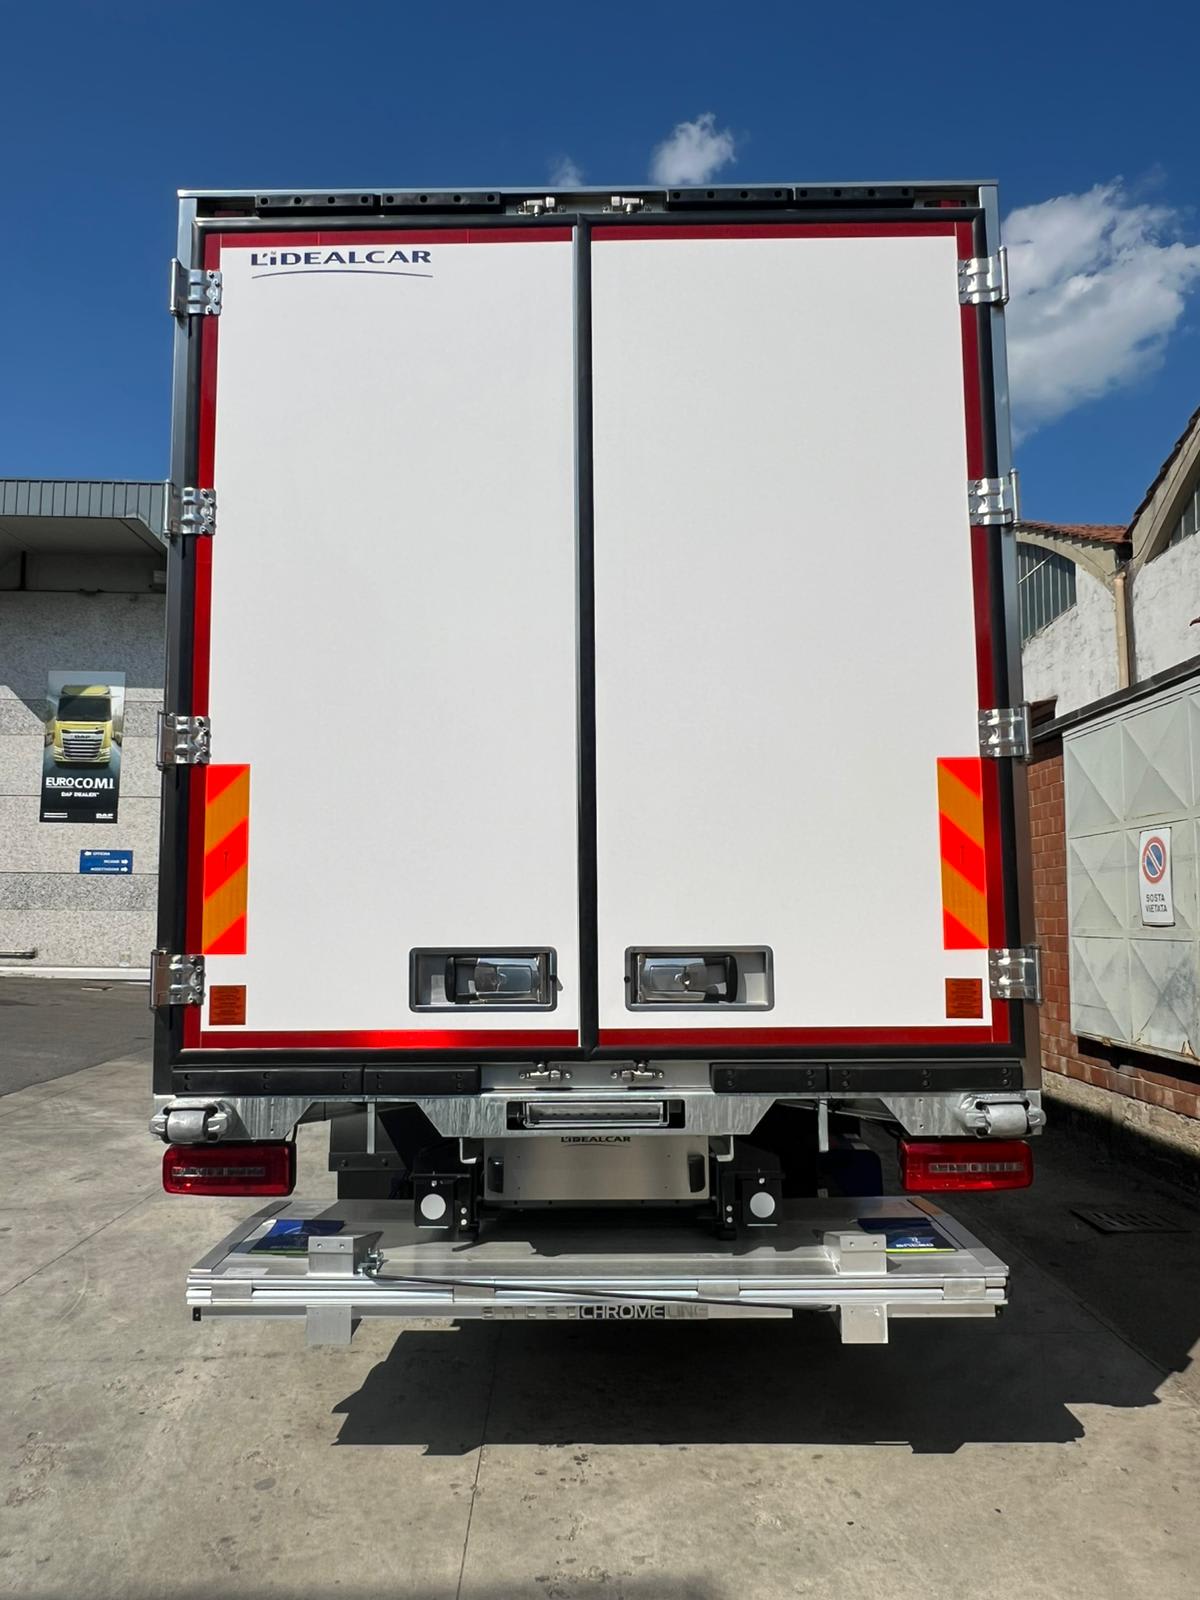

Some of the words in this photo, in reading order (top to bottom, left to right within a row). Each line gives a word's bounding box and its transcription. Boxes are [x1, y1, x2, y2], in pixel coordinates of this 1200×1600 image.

[46, 777, 115, 789] EUROCOMI
[1146, 893, 1165, 902] SOSTA
[1145, 904, 1168, 912] VIETATA
